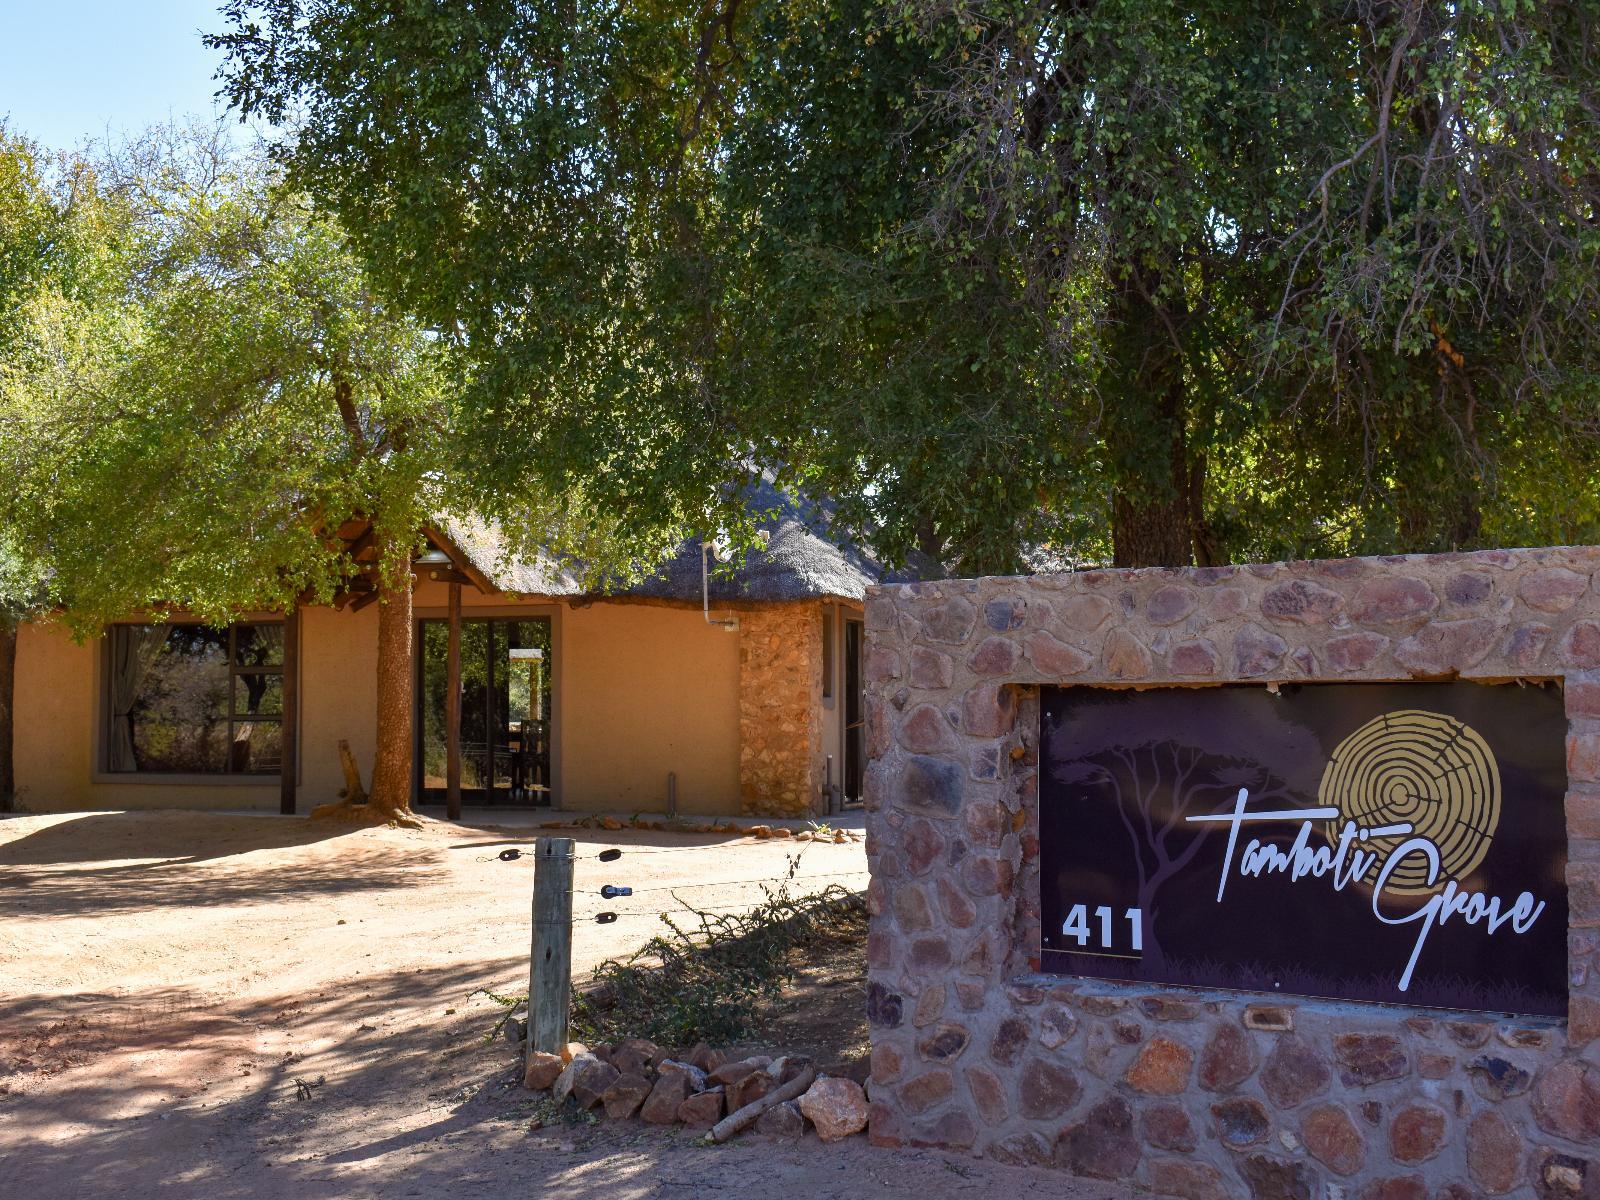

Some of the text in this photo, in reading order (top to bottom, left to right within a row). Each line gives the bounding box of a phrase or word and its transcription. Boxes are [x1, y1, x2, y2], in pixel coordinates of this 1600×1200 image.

[1062, 904, 1143, 951] 411
[1186, 788, 1546, 992] Tamboti Grove
